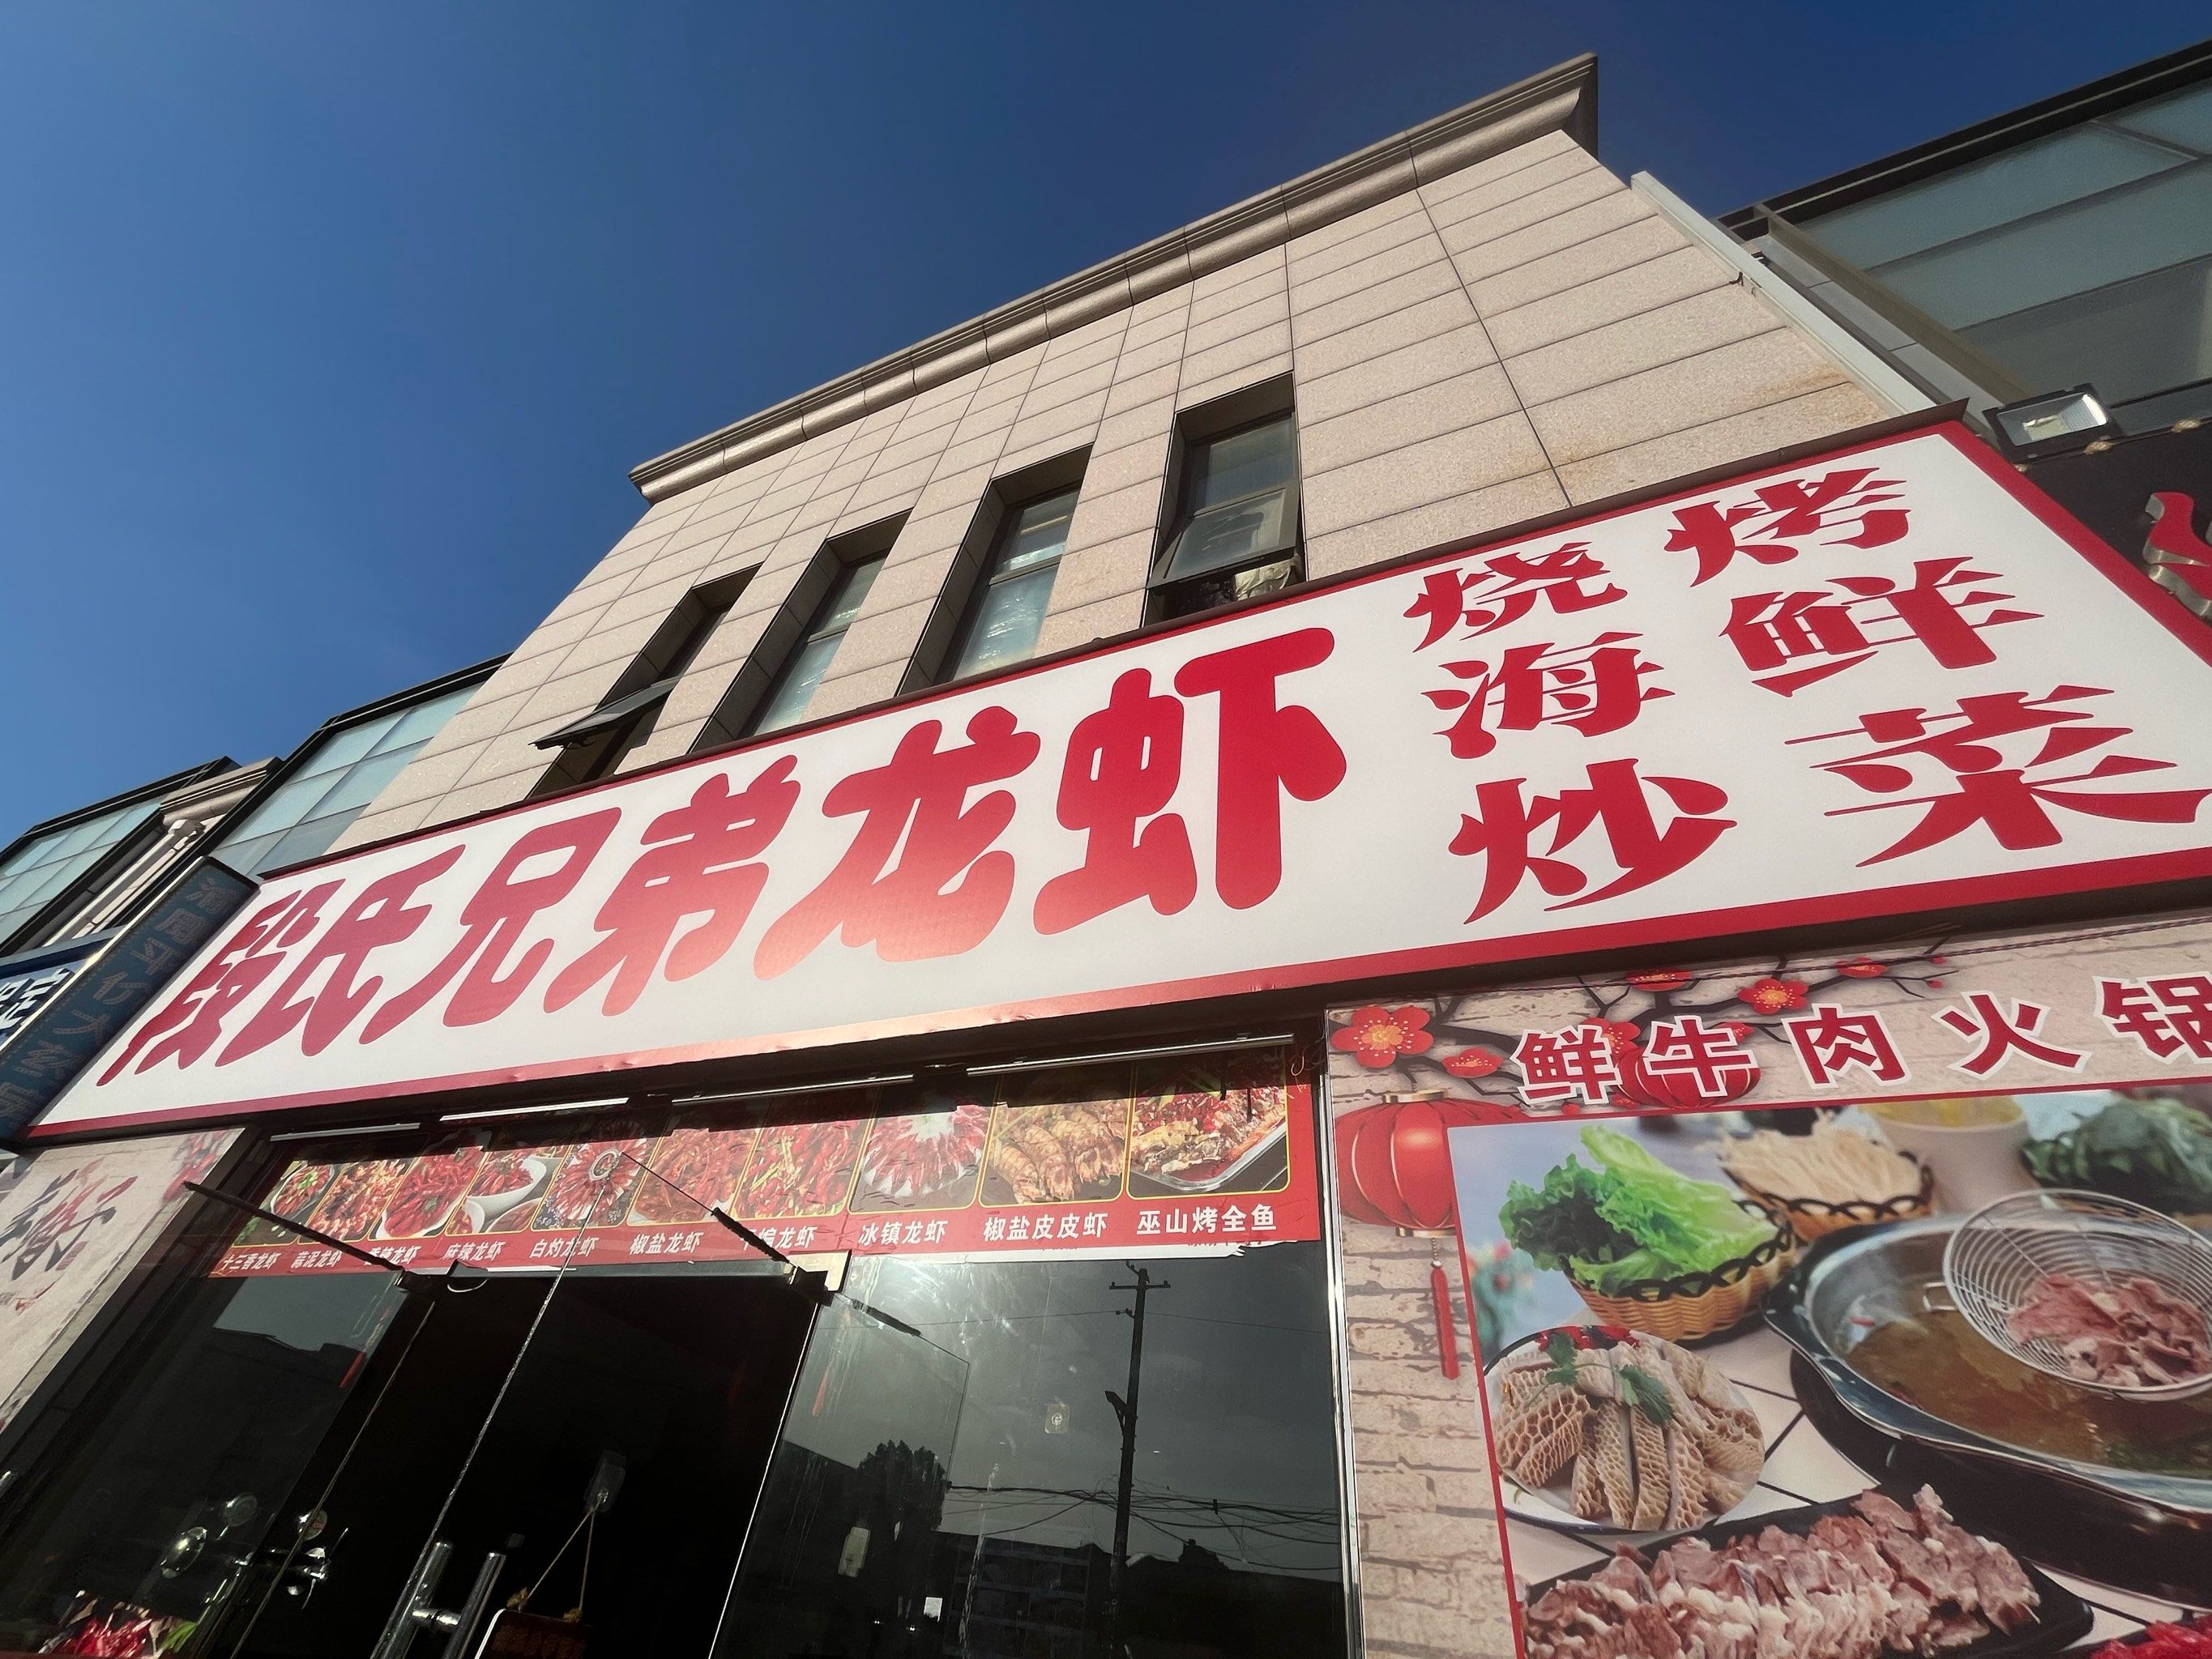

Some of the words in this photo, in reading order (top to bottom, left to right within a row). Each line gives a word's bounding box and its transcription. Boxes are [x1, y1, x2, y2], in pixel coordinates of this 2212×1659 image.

[1403, 467, 1911, 653] 烧烤
[1421, 557, 2044, 760] 海鲜
[1448, 684, 2212, 926] 炒菜
[96, 626, 1348, 1088] 段氏兄弟龙虾
[1511, 972, 2212, 1104] 鲜牛肉火锅
[857, 1219, 949, 1247] 冰镇龙虾
[982, 1211, 1109, 1243] 椒盐皮皮虾
[1136, 1203, 1278, 1236] 巫山烤全鱼
[290, 1249, 344, 1269] 蒜泥龙虾
[441, 1241, 506, 1261] 麻辣龙虾
[529, 1236, 600, 1259] 白灼龙虾
[629, 1231, 704, 1256] 椒盐龙虾
[221, 1252, 282, 1271] 十三香龙虾
